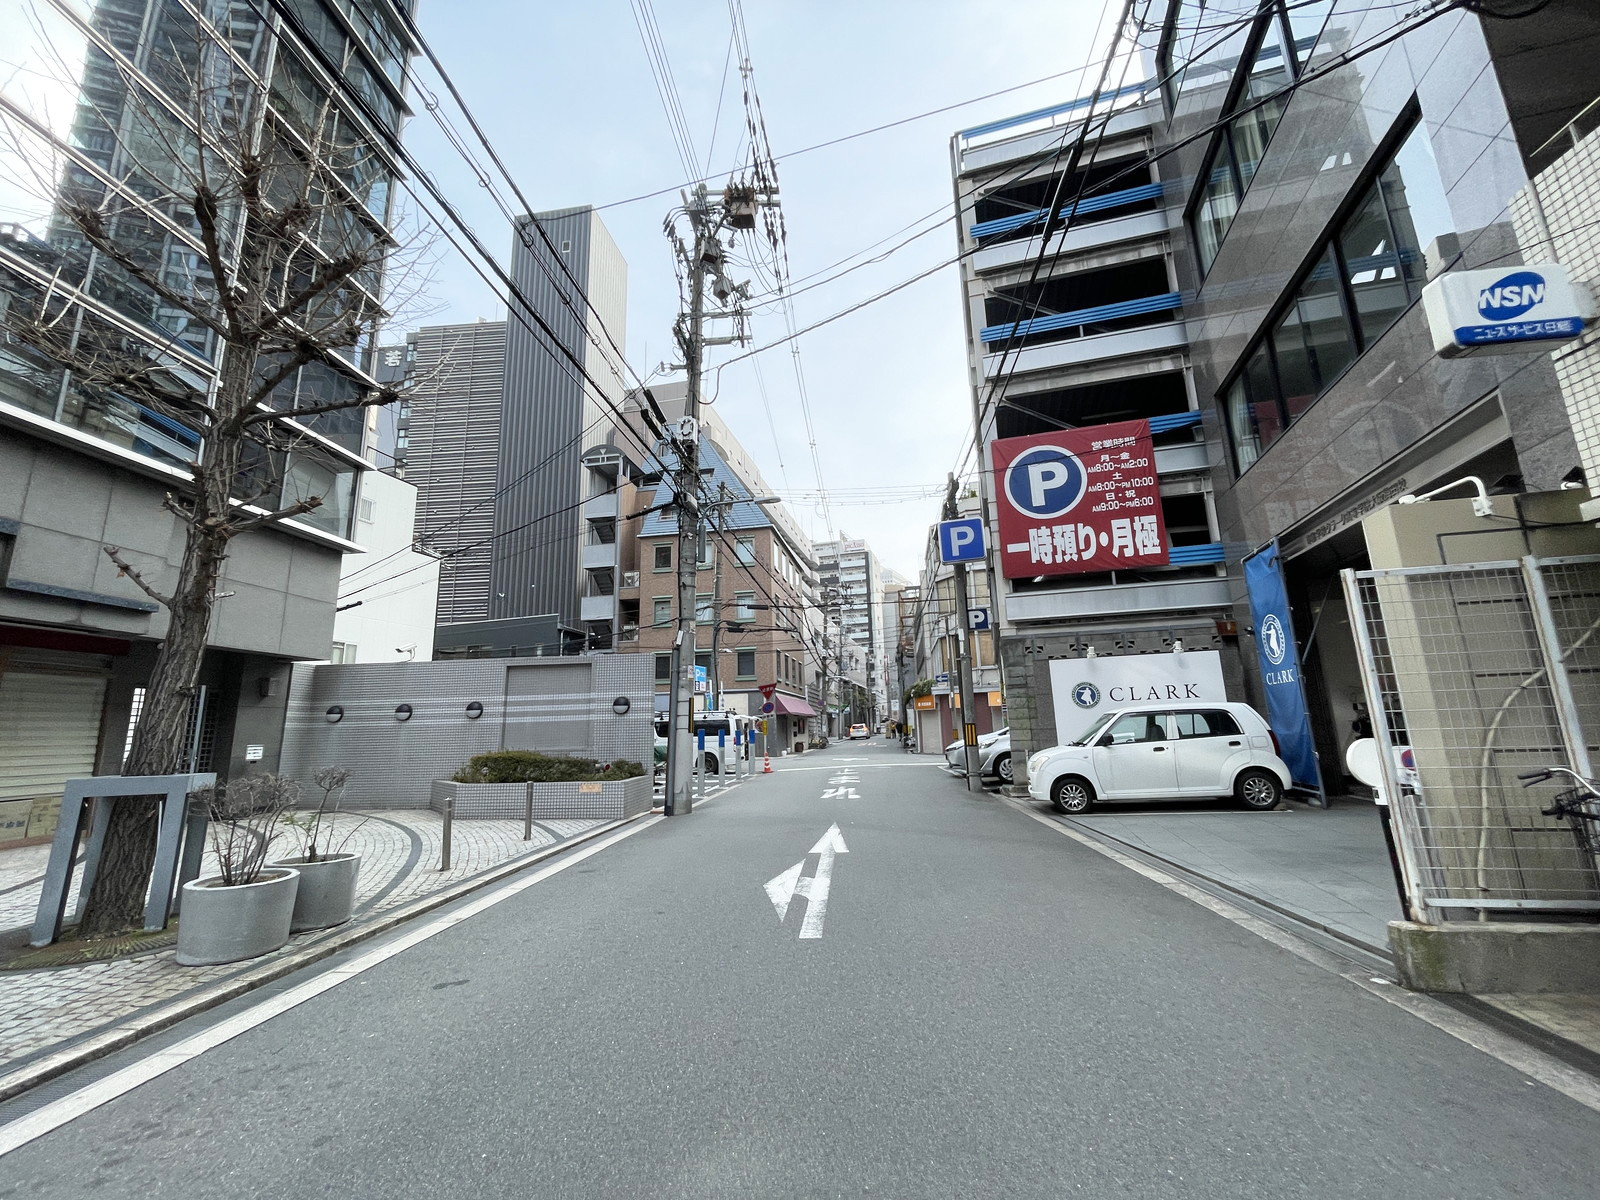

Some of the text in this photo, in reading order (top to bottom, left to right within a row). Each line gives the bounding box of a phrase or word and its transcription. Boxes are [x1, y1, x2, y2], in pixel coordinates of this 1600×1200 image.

[1479, 284, 1544, 309] NSN
[1091, 436, 1136, 451] 営業時間
[1028, 461, 1069, 507] P
[1112, 471, 1123, 480] 土
[950, 526, 975, 557] P
[1006, 514, 1162, 565] 一時預り・月極
[968, 610, 985, 629] P
[1265, 669, 1295, 686] CLARK
[1109, 683, 1201, 702] CLARK
